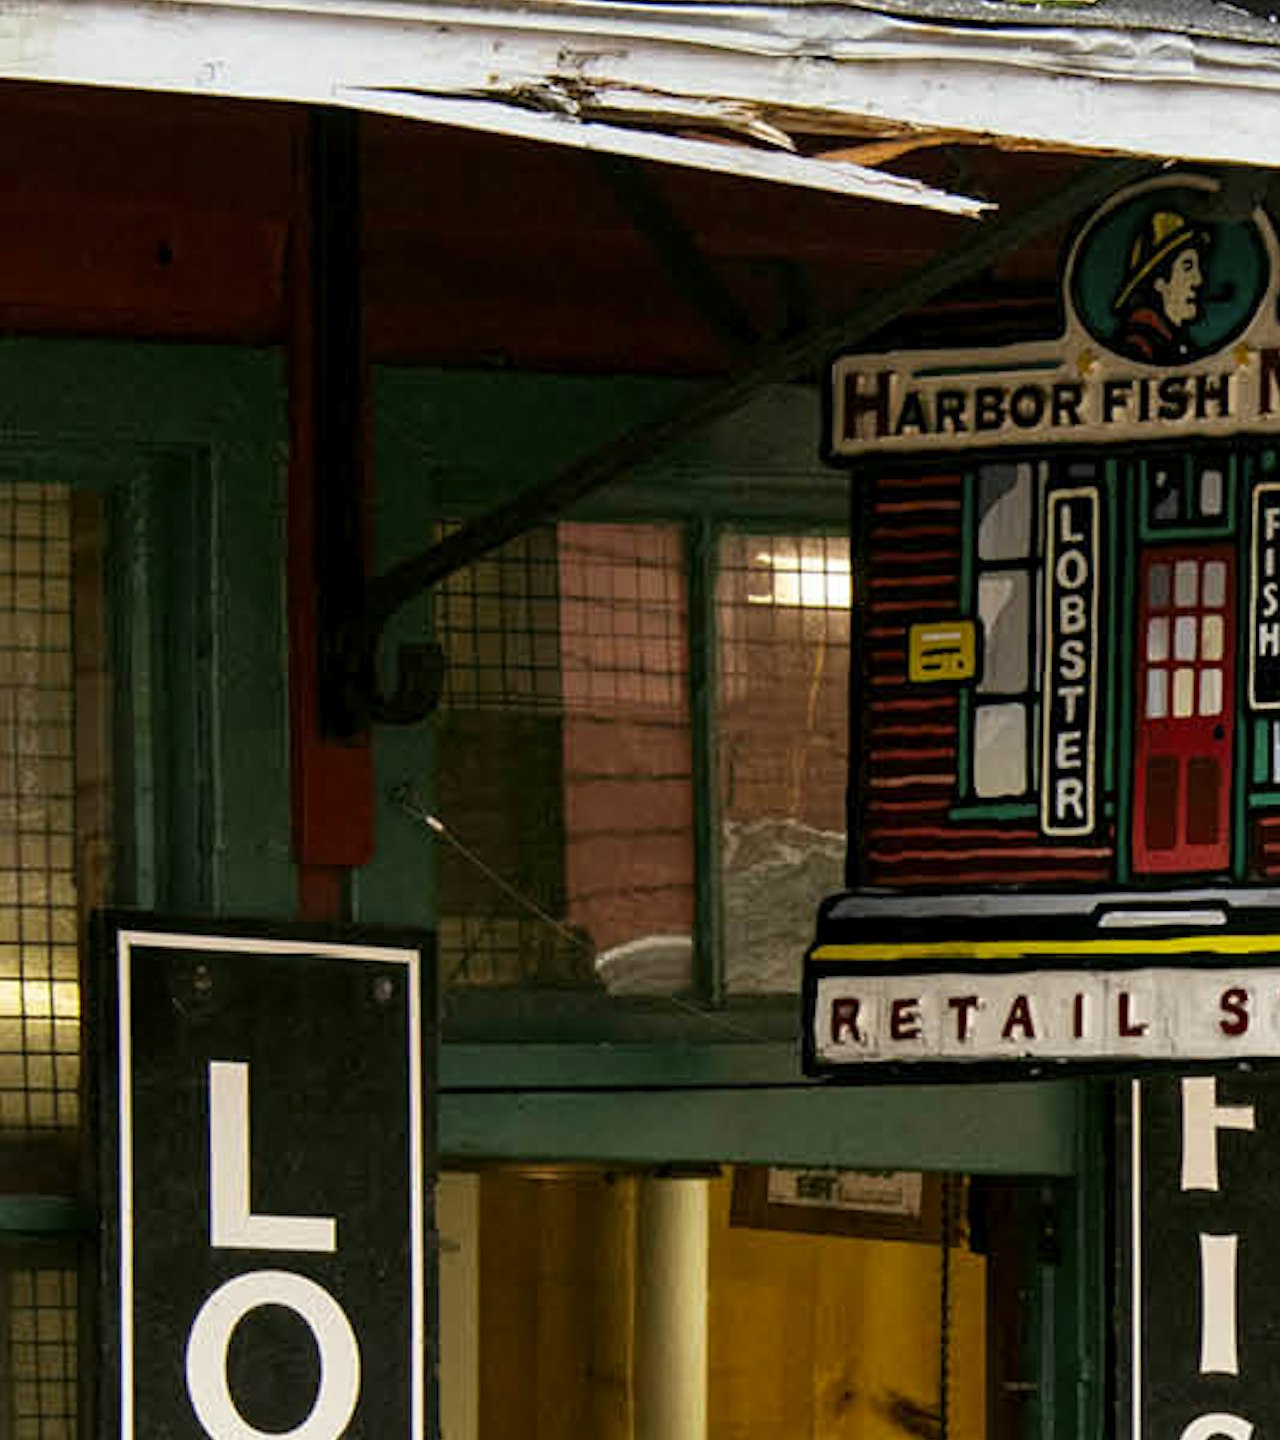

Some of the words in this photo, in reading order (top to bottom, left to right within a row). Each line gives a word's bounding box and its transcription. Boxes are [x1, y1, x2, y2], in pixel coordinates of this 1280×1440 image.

[844, 367, 1082, 442] HARBOR
[1102, 368, 1230, 424] FISH
[1258, 507, 1280, 658] FISH
[1056, 500, 1089, 819] LOBSTER
[831, 993, 1148, 1044] RETAIL
